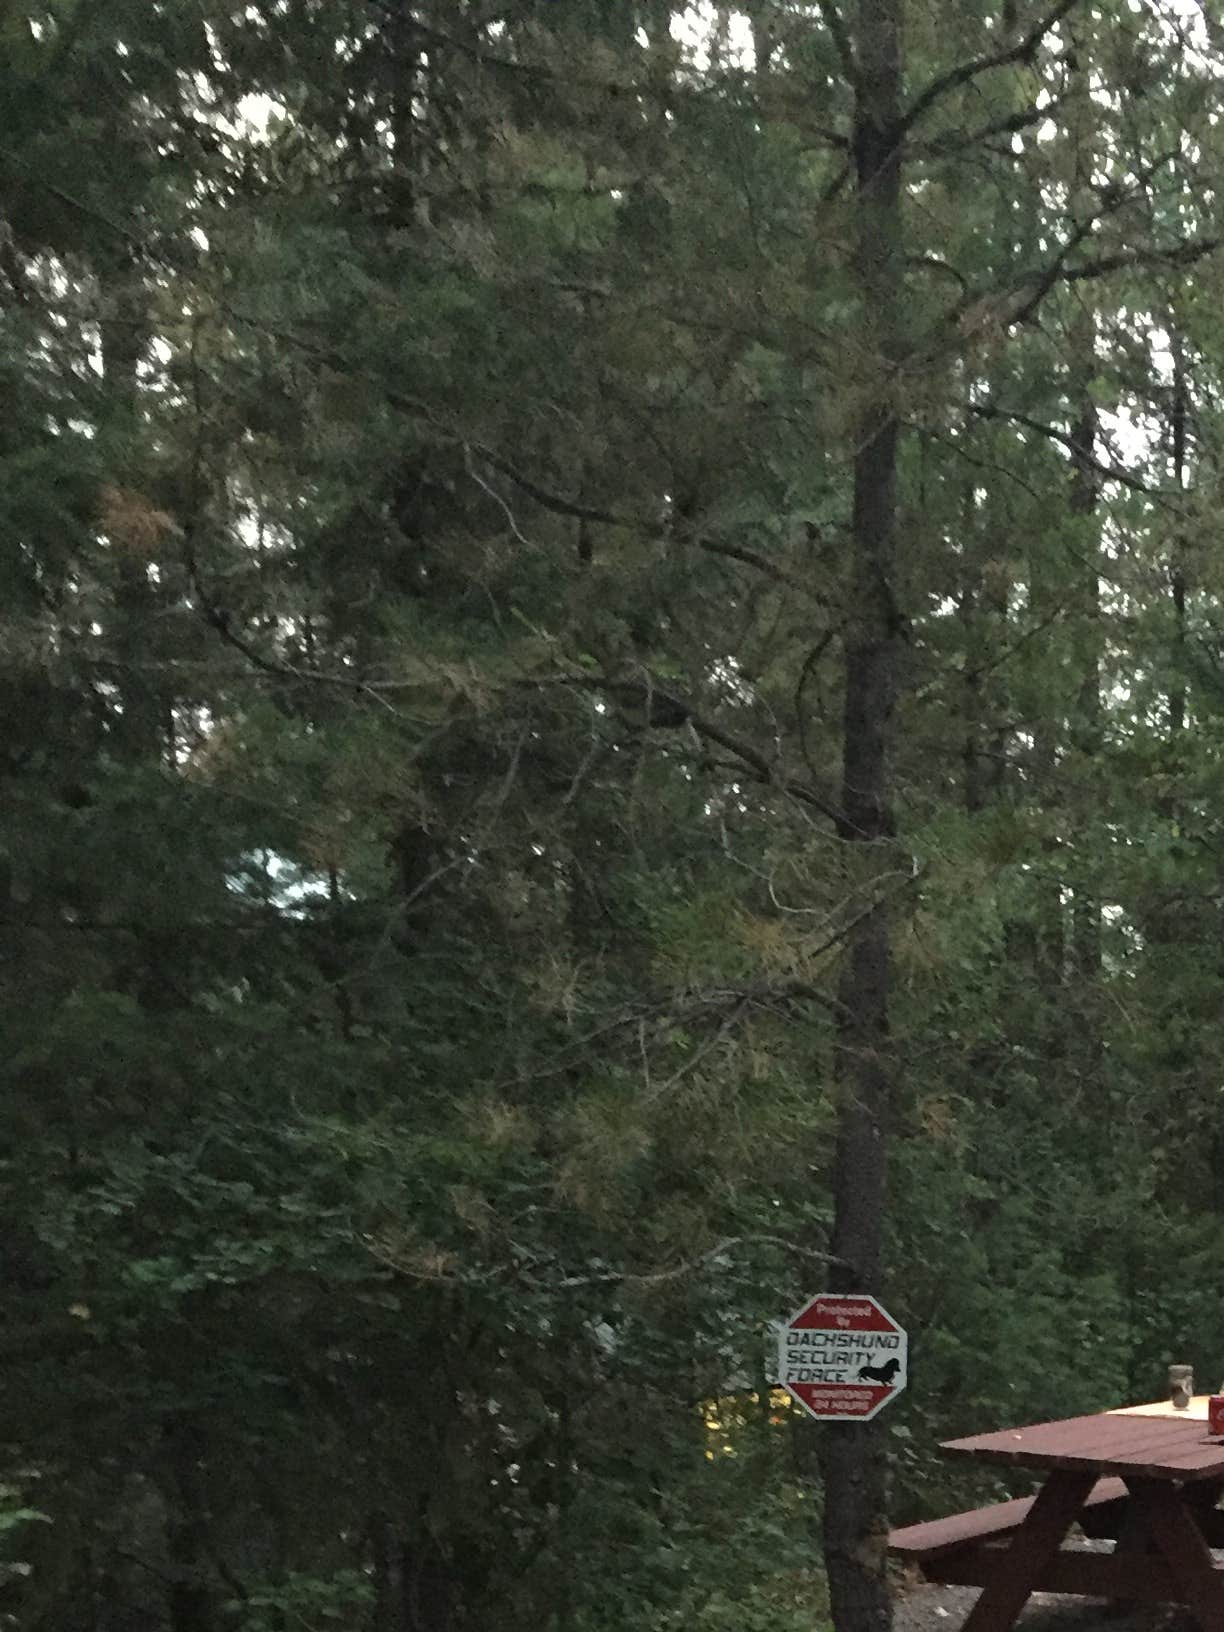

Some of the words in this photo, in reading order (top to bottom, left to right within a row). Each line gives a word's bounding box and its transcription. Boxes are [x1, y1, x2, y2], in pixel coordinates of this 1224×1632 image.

[786, 1332, 900, 1349] DACHSHUND
[787, 1350, 876, 1365] SECURITY
[786, 1367, 849, 1383] FORCE
